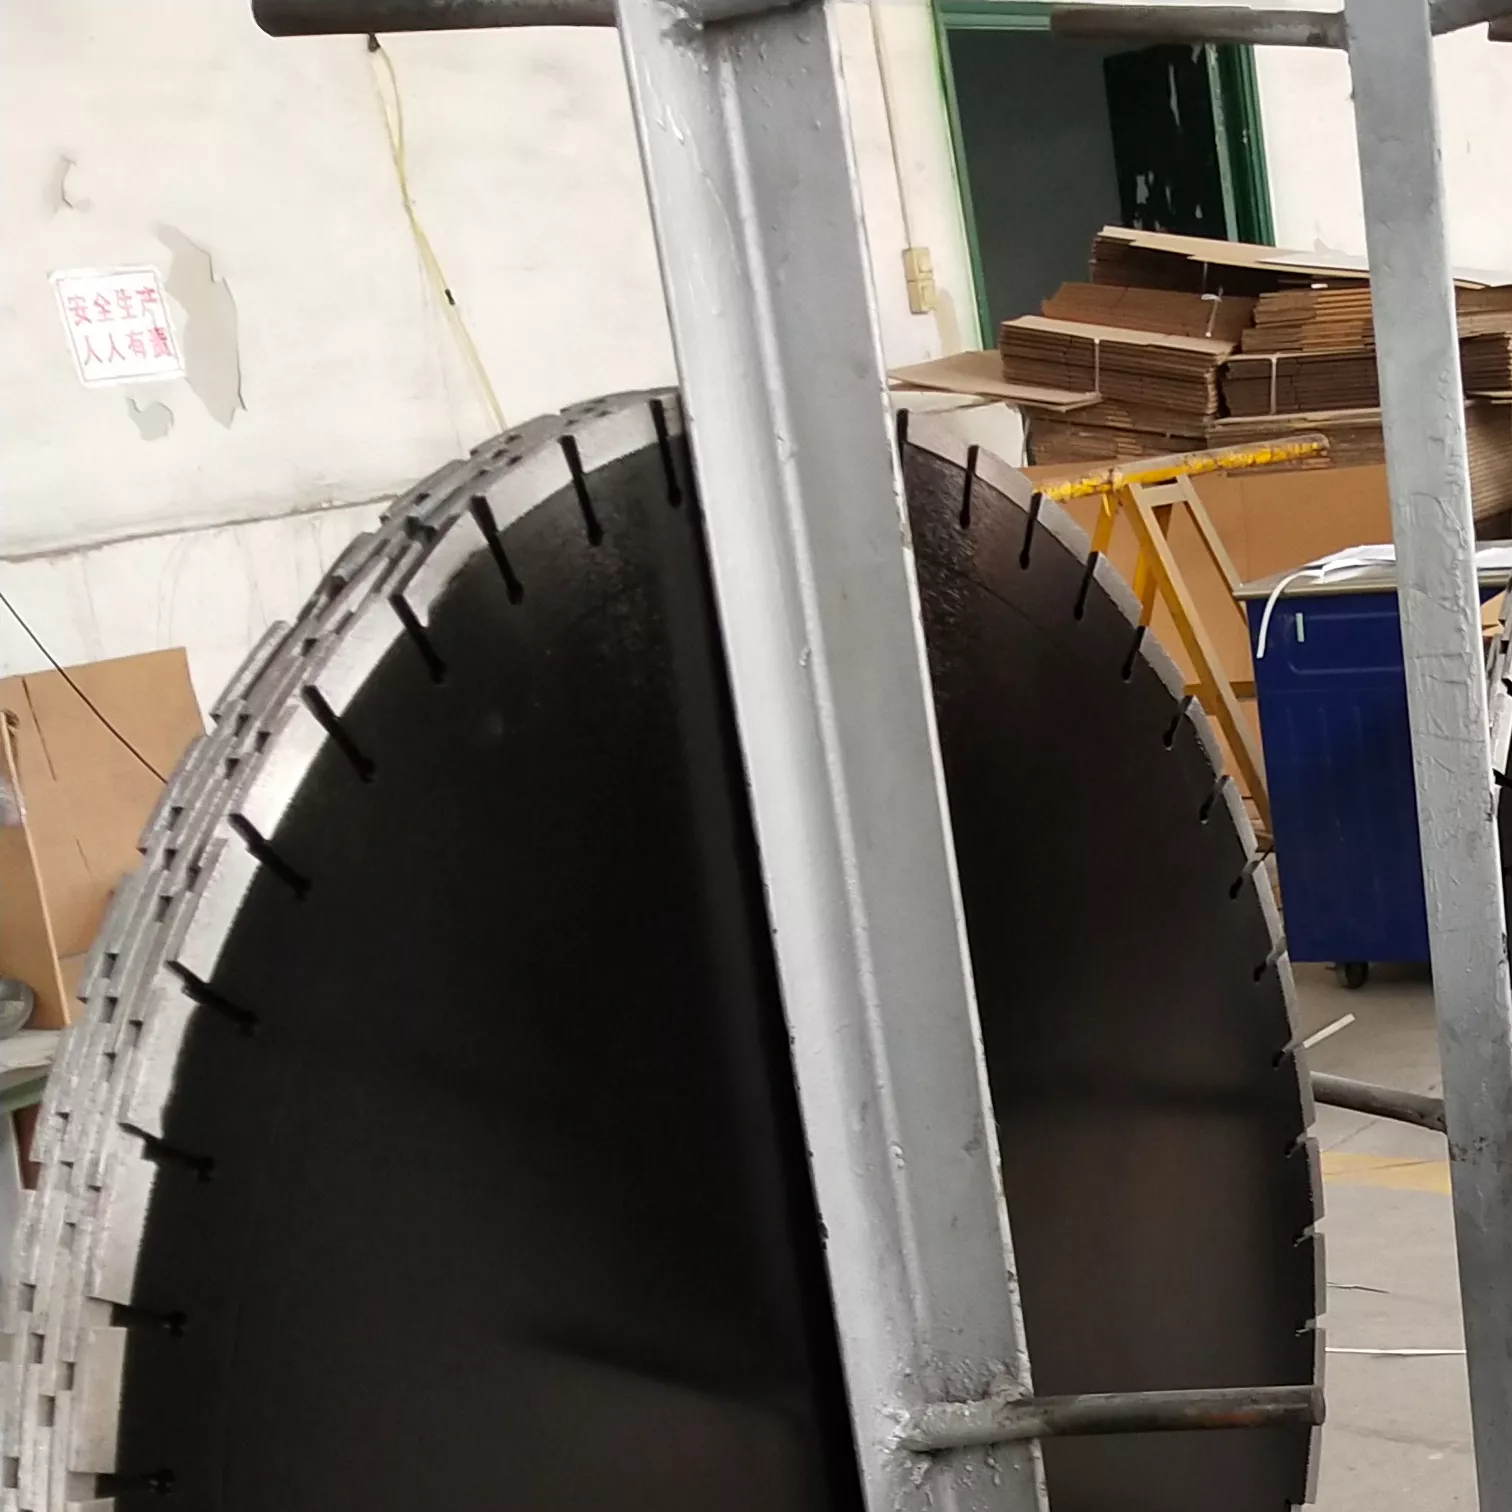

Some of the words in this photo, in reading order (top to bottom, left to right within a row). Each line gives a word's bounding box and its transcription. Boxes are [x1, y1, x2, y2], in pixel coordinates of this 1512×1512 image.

[68, 285, 157, 326] 安全生产
[84, 326, 172, 366] 人人有责
